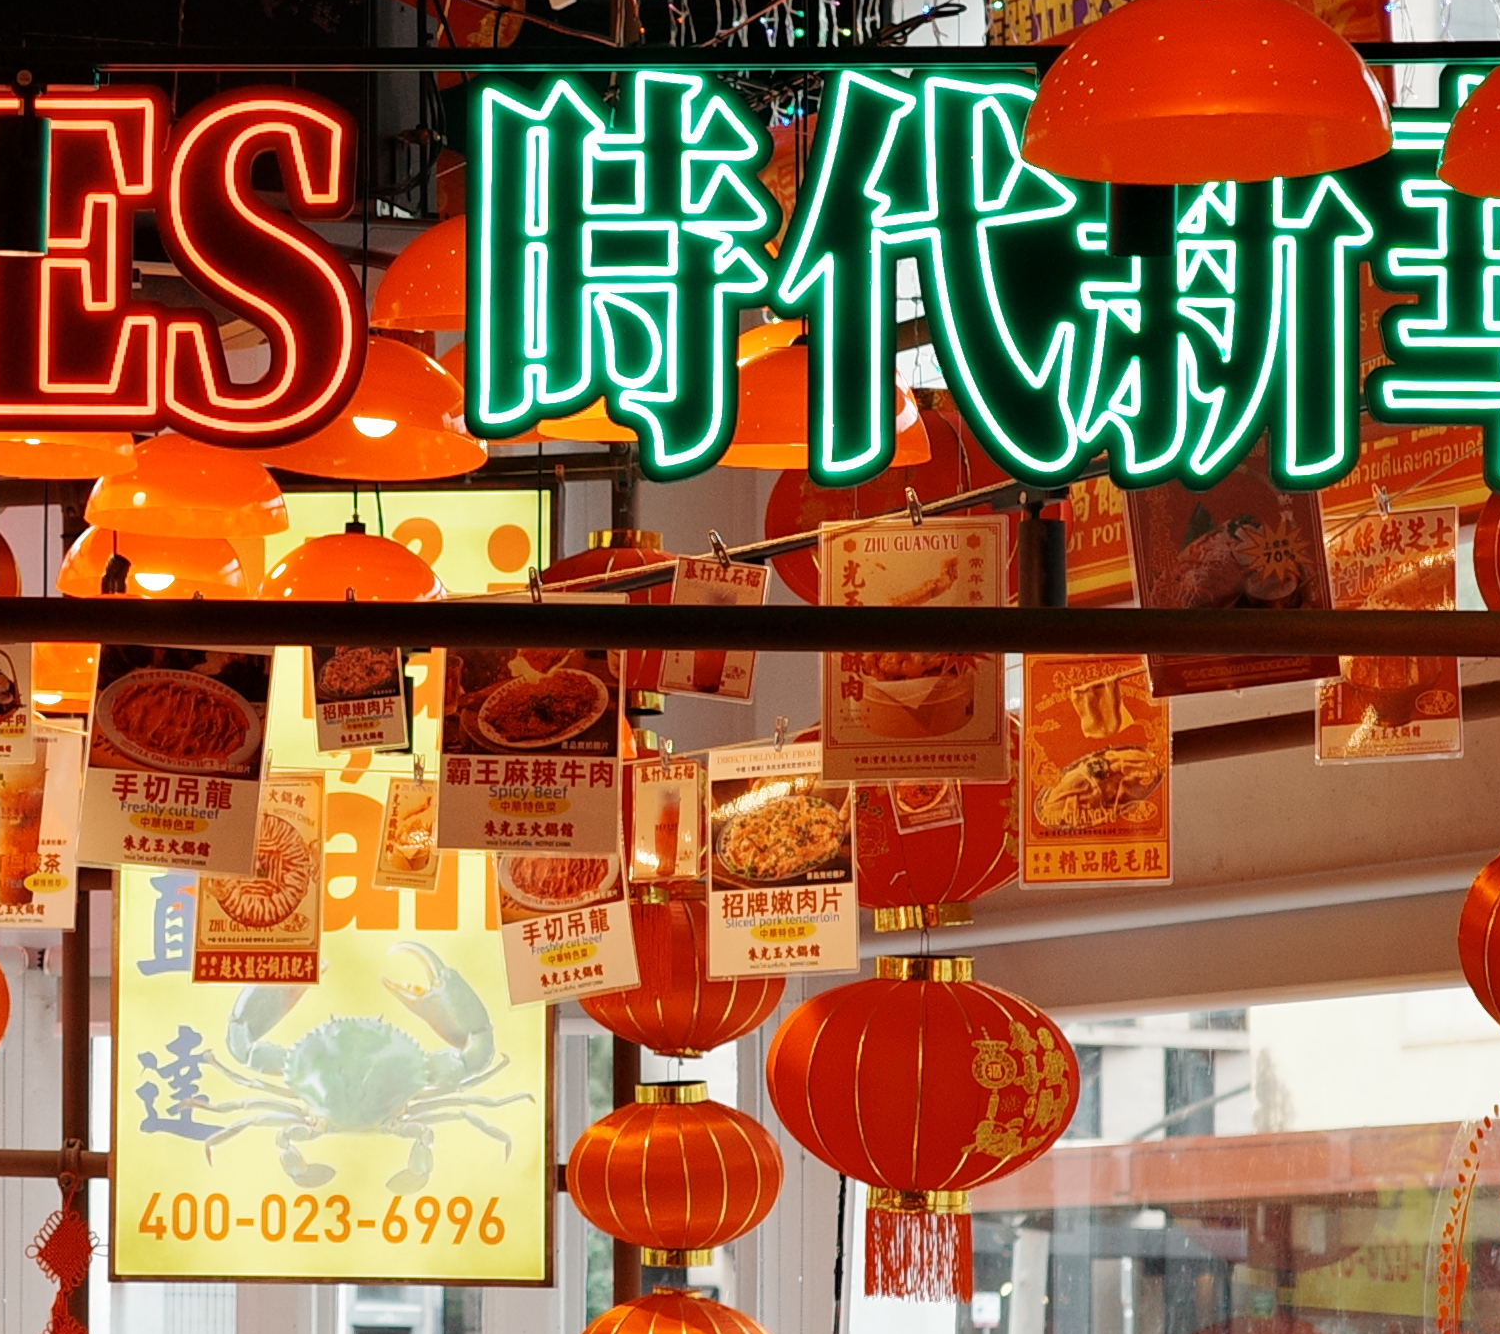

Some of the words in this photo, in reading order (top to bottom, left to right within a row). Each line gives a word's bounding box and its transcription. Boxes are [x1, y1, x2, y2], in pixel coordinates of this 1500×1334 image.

[863, 536, 891, 553] ZHU
[893, 534, 941, 552] GUANG
[942, 533, 961, 551] YU
[840, 559, 867, 702] 光玉酥肉
[446, 758, 615, 789] 霸王麻辣牛肉
[111, 772, 233, 810] 手切吊龍
[488, 784, 530, 802] Spicy
[533, 784, 569, 799] Beef
[119, 800, 166, 819] Freshly
[168, 805, 189, 817] cut
[190, 805, 220, 820] beef
[139, 818, 196, 832] 中華特色菜
[1057, 848, 1164, 875] 精品脆毛肚
[721, 889, 843, 920] 招牌嫩肉片
[785, 911, 840, 926] tenderloin
[521, 907, 611, 947] 手切吊龍
[137, 1193, 508, 1247] 400-023-6996
